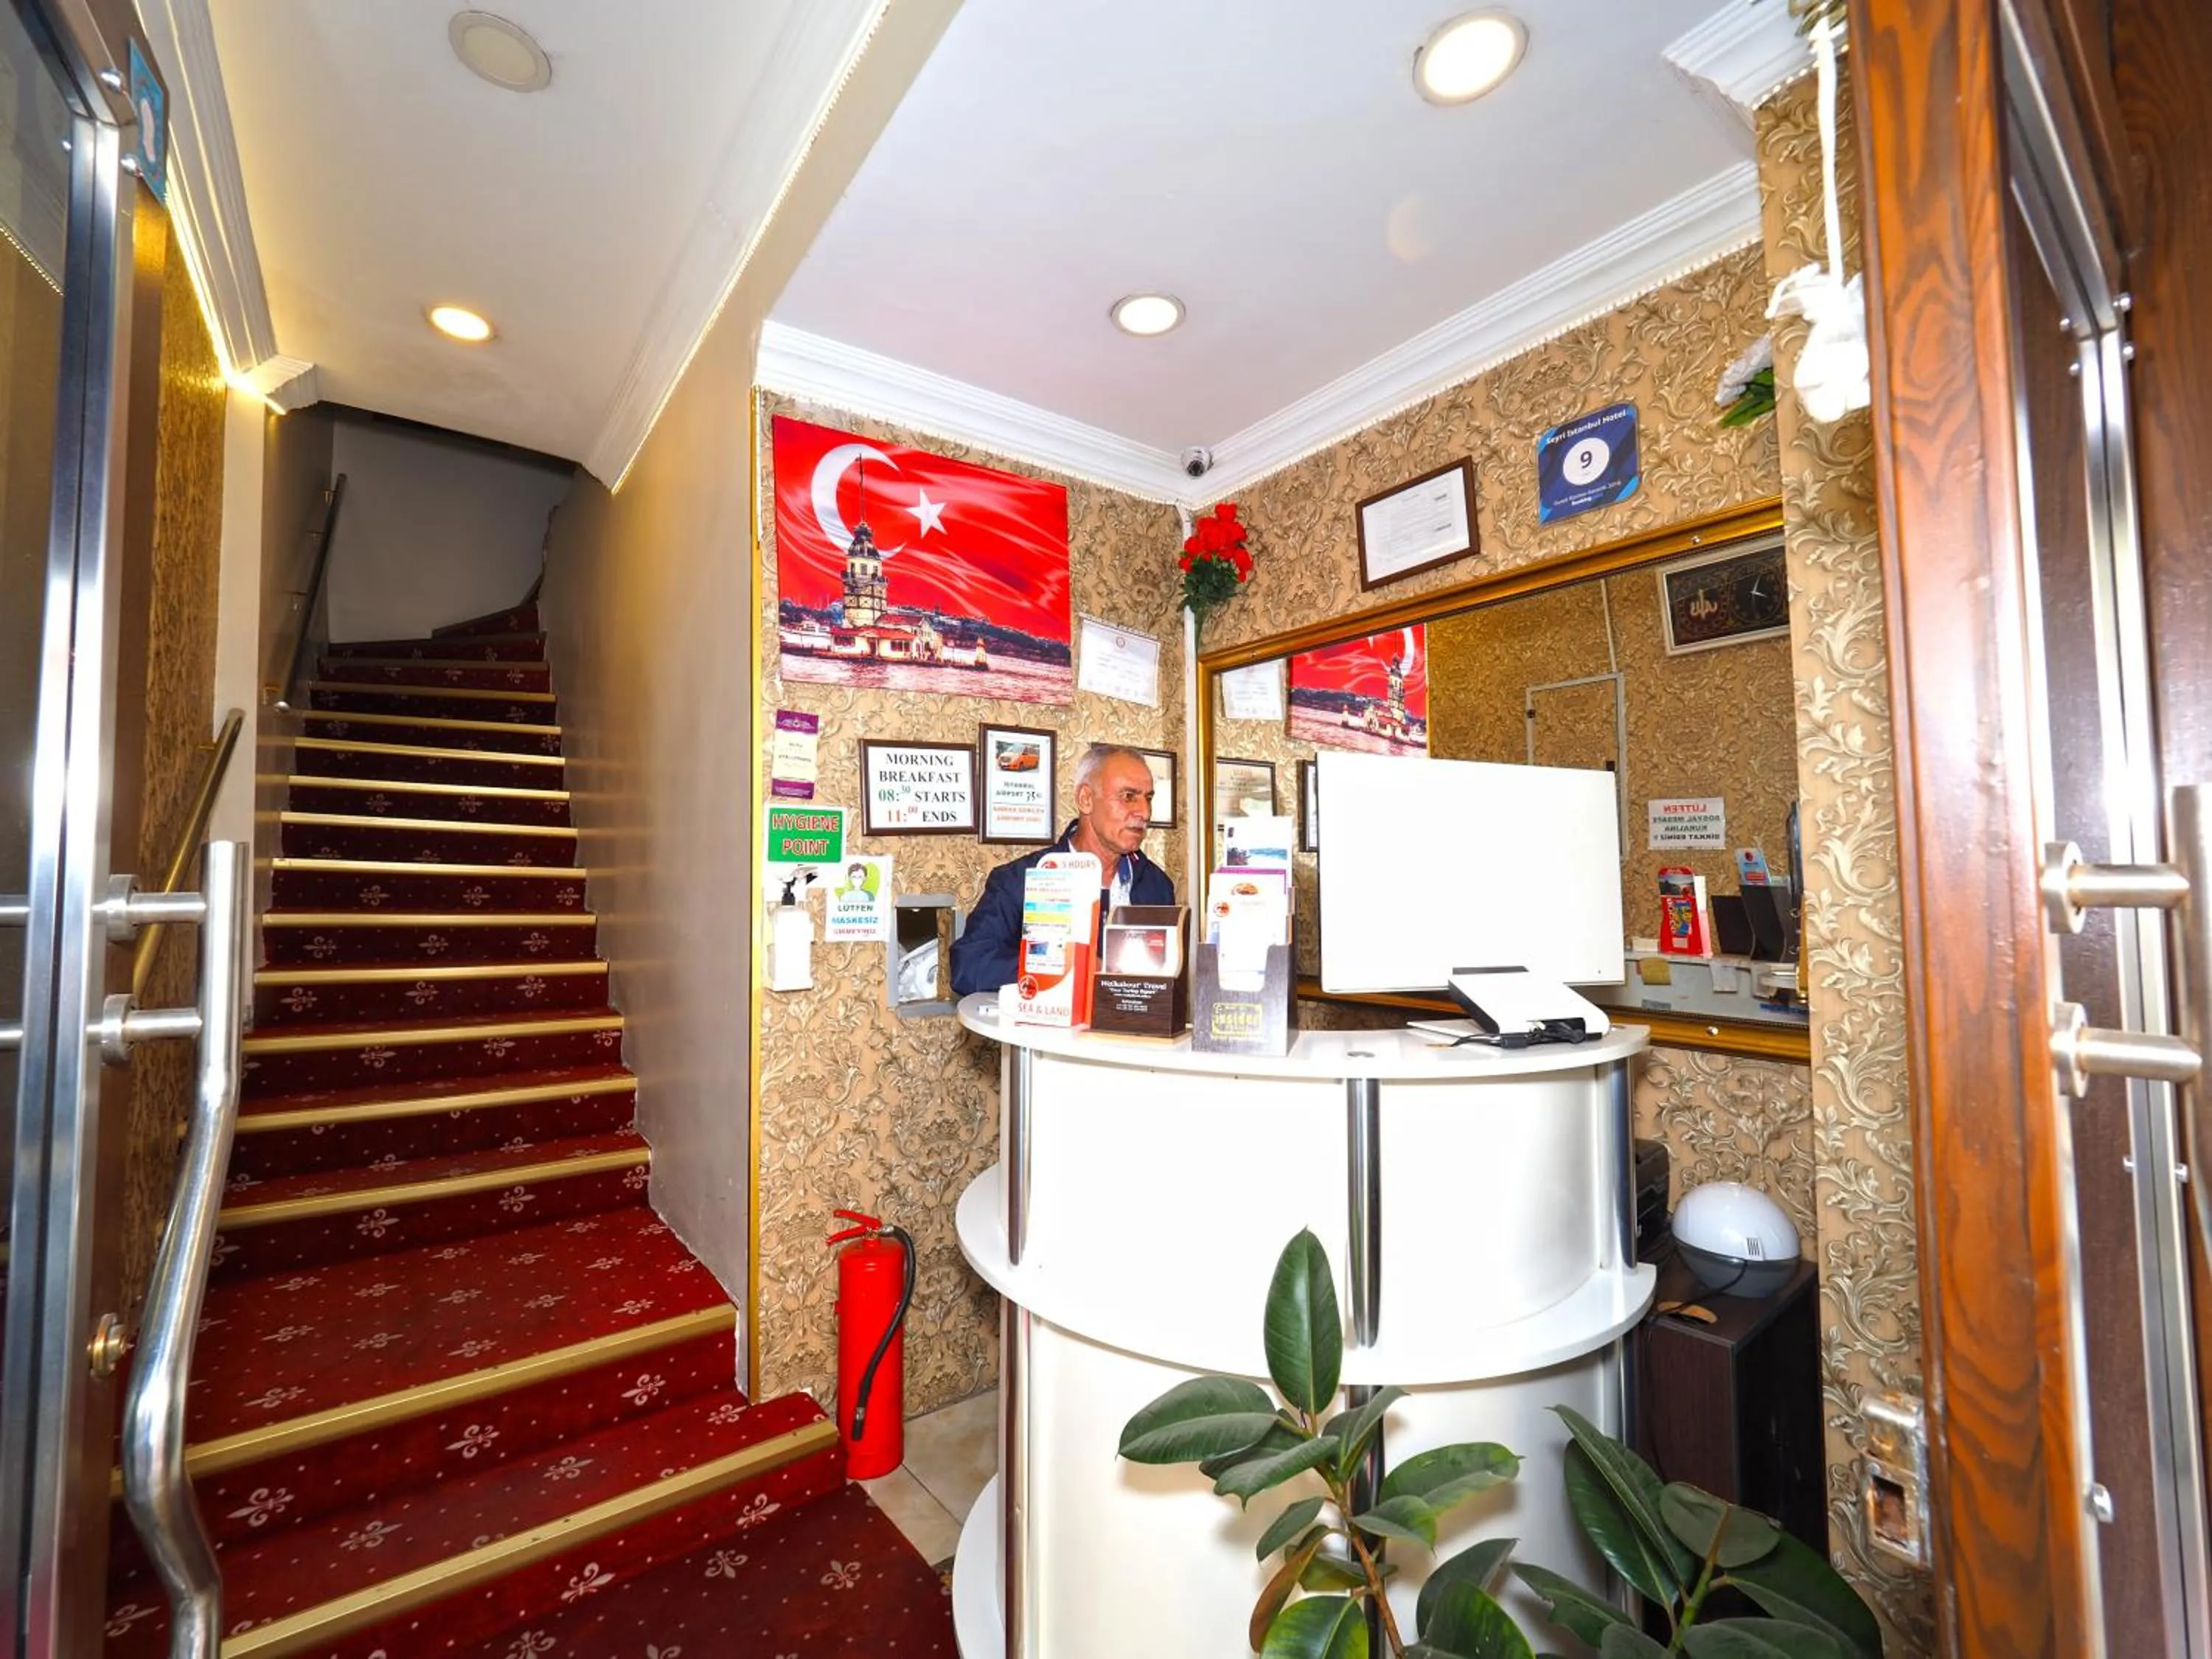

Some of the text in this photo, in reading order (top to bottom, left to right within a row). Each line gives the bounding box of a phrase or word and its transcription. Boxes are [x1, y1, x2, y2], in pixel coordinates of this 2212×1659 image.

[1567, 419, 1601, 437] Istanbul
[1602, 409, 1627, 424] Hotel
[1580, 451, 1593, 469] 9
[886, 753, 953, 766] MORNING
[879, 771, 960, 783] BREAKFAST
[914, 791, 966, 802] STARTS
[772, 813, 839, 832] HYGIENE
[922, 811, 957, 822] ENDS
[782, 838, 830, 856] POINT
[1018, 1002, 1033, 1013] SEA
